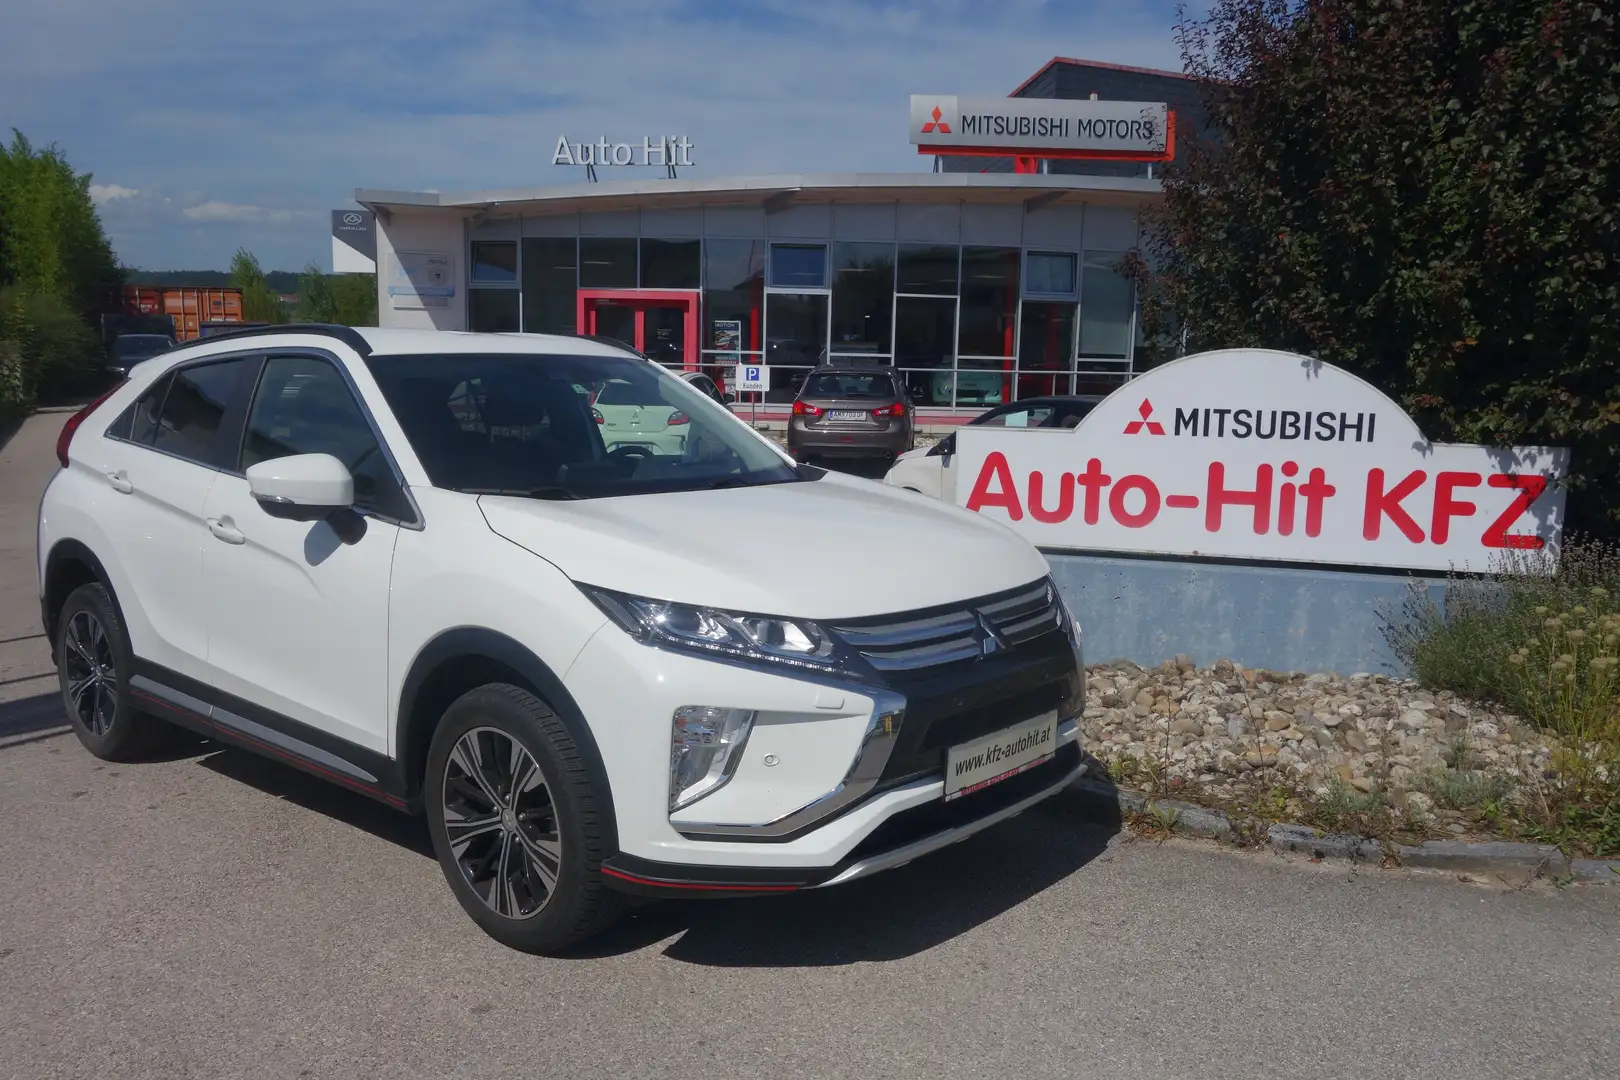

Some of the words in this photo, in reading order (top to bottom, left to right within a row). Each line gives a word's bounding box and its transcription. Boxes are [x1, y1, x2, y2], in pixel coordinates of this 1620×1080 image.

[961, 115, 1069, 137] MITSUBISHI
[1077, 118, 1153, 140] MOTORS
[552, 134, 633, 166] Auto
[643, 134, 695, 166] Hit
[748, 368, 757, 381] P
[1174, 407, 1375, 443] MITSUBISHI
[966, 451, 1336, 537] Auto-Hit
[1363, 468, 1546, 549] KFZ
[955, 727, 1051, 777] www.kfz-autohit.at
